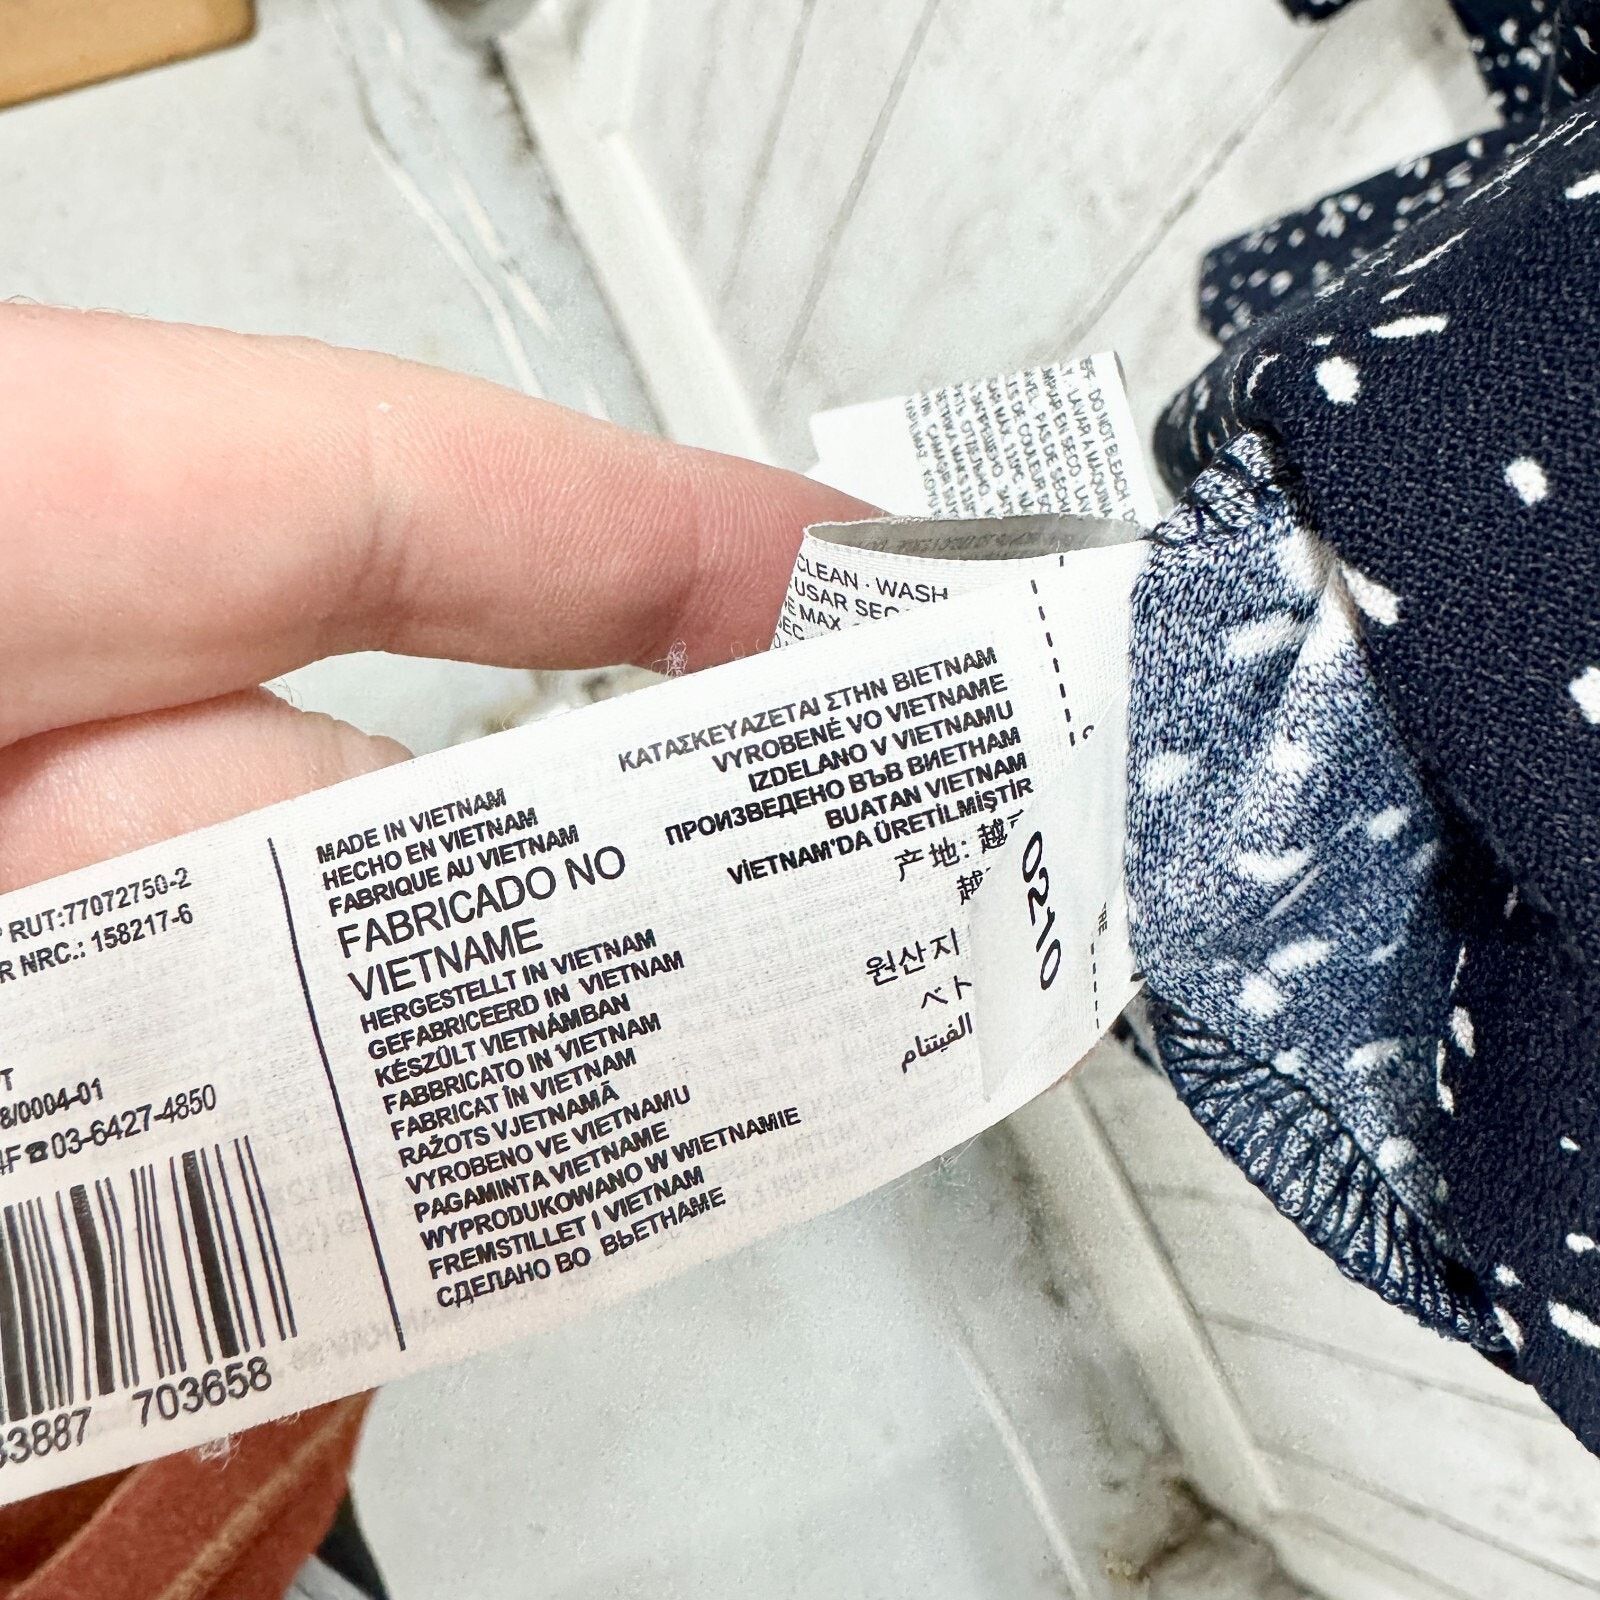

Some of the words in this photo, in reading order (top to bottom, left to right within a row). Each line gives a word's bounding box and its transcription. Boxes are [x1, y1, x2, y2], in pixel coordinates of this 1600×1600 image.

[794, 576, 849, 612] USAR
[797, 553, 859, 590] CLEAN
[875, 577, 948, 603] WASH
[799, 604, 841, 631] MAX
[749, 744, 867, 792] IZDELANO
[873, 730, 891, 757] V
[891, 700, 1014, 751] VIETNAMU
[849, 709, 883, 735] VO
[886, 674, 1007, 724] VIETNAME
[317, 824, 380, 864] MADE
[384, 816, 407, 843] IN
[409, 788, 507, 833] VIETNAM
[665, 778, 845, 846] ПРОИЗВЕДЕНО
[850, 760, 903, 793] ВЪВ
[909, 727, 1021, 778] ВИЕТНАМ
[825, 788, 921, 830] BUATAN
[925, 752, 1027, 799] VIETNAM
[874, 777, 1033, 845] ÜRETİLMİŞTİR
[322, 849, 402, 891] HECHO
[408, 842, 437, 867] EN
[439, 807, 538, 854] VIETNAM
[329, 871, 443, 917] FABRIQUE
[447, 856, 475, 883] AU
[478, 825, 579, 870] VIETNAM
[9, 866, 192, 944] RUT:77072750-2
[21, 937, 86, 974] NRC.:
[91, 904, 194, 955] 158217-6
[337, 866, 557, 959] FABRICADO
[564, 845, 626, 890] NO
[1021, 830, 1062, 991] 0210
[347, 917, 544, 1002] VIETNAME
[360, 970, 516, 1034] HERGESTELLT
[522, 960, 548, 986] IN
[551, 928, 656, 977] VIETNAM
[866, 927, 960, 987] 원산지
[368, 994, 540, 1060] GEFABRICEERD
[544, 982, 571, 1008] IN
[578, 950, 684, 997] VIETNAM
[480, 993, 631, 1057] VIETNÁMBAN
[383, 1059, 524, 1115] FABBRICATO
[529, 1048, 553, 1074] IN
[556, 1013, 661, 1064] VIETNAM
[391, 1087, 499, 1140] FABRICAT
[503, 1083, 530, 1109] ÎN
[532, 1048, 637, 1100] VIETNAM
[51, 1083, 217, 1163] 03-6427-4850
[398, 1125, 493, 1168] RAŽOTS
[406, 1143, 532, 1195] VYROBENO
[537, 1134, 570, 1164] VE
[571, 1085, 691, 1150] VIETNAMU
[413, 1170, 549, 1223] PAGAMINTA
[551, 1122, 669, 1184] VIETNAME
[420, 1163, 643, 1250] WYPRODUKOWANO
[645, 1149, 671, 1174] W
[672, 1106, 802, 1168] WIETNAMIE
[429, 1216, 587, 1279] FREMSTILLET
[592, 1211, 601, 1228] I
[602, 1166, 704, 1220] VIETNAM
[436, 1256, 552, 1308] СДЕЛАНО
[556, 1245, 591, 1272] ВО
[600, 1186, 727, 1257] ВЬЕТНАМЕ
[133, 1357, 273, 1429] 703658
